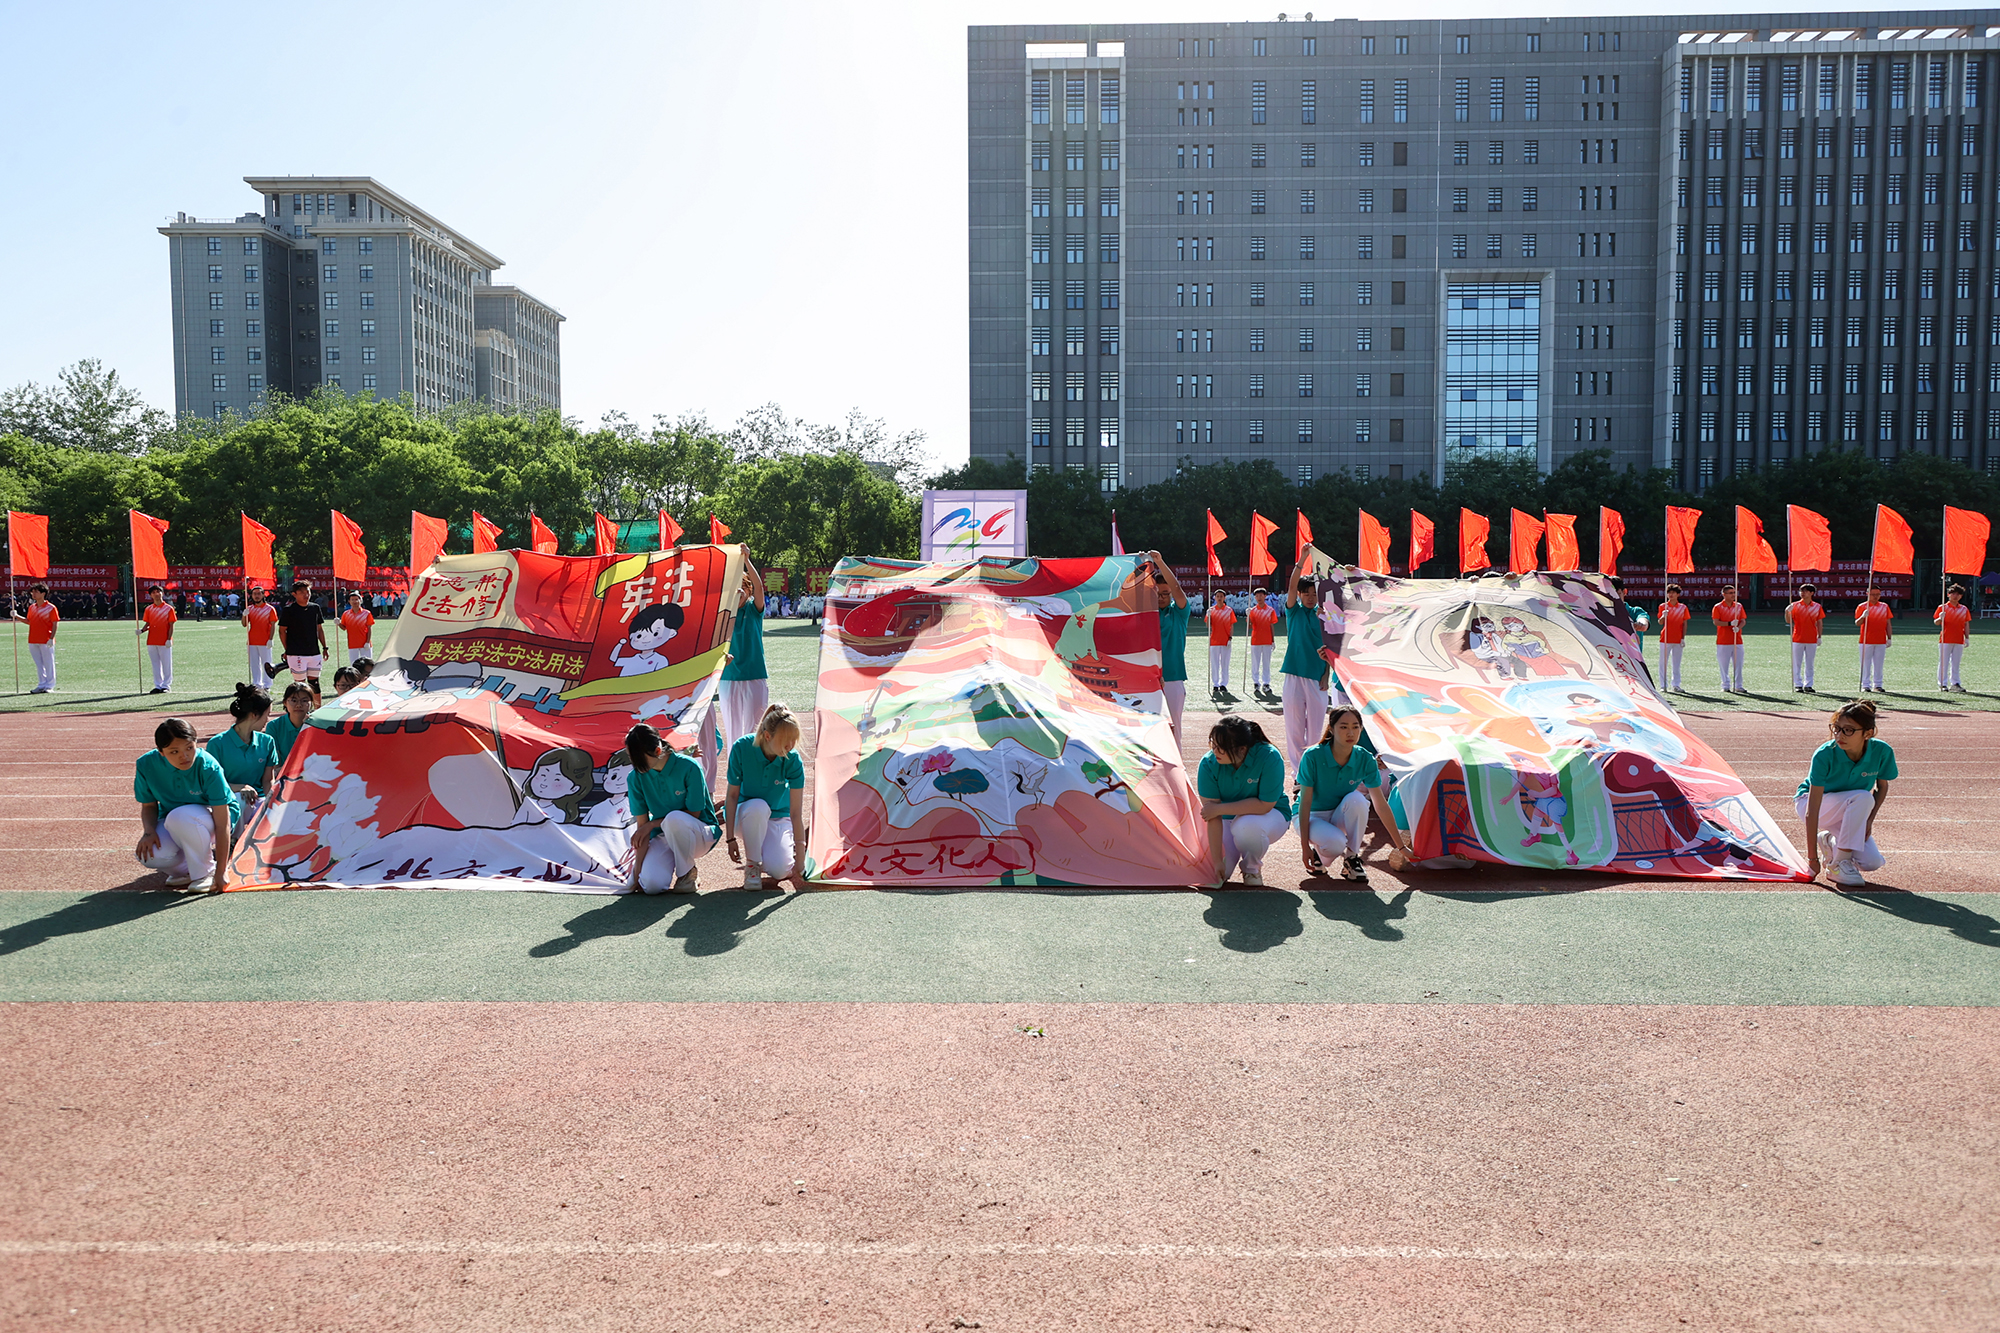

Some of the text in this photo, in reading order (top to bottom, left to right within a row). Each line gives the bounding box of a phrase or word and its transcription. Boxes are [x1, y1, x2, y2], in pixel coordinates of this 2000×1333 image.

[619, 561, 694, 624] 宪法
[763, 571, 786, 592] 春
[421, 640, 585, 676] 尊法学法守法用法
[831, 843, 1027, 877] 以文化人
